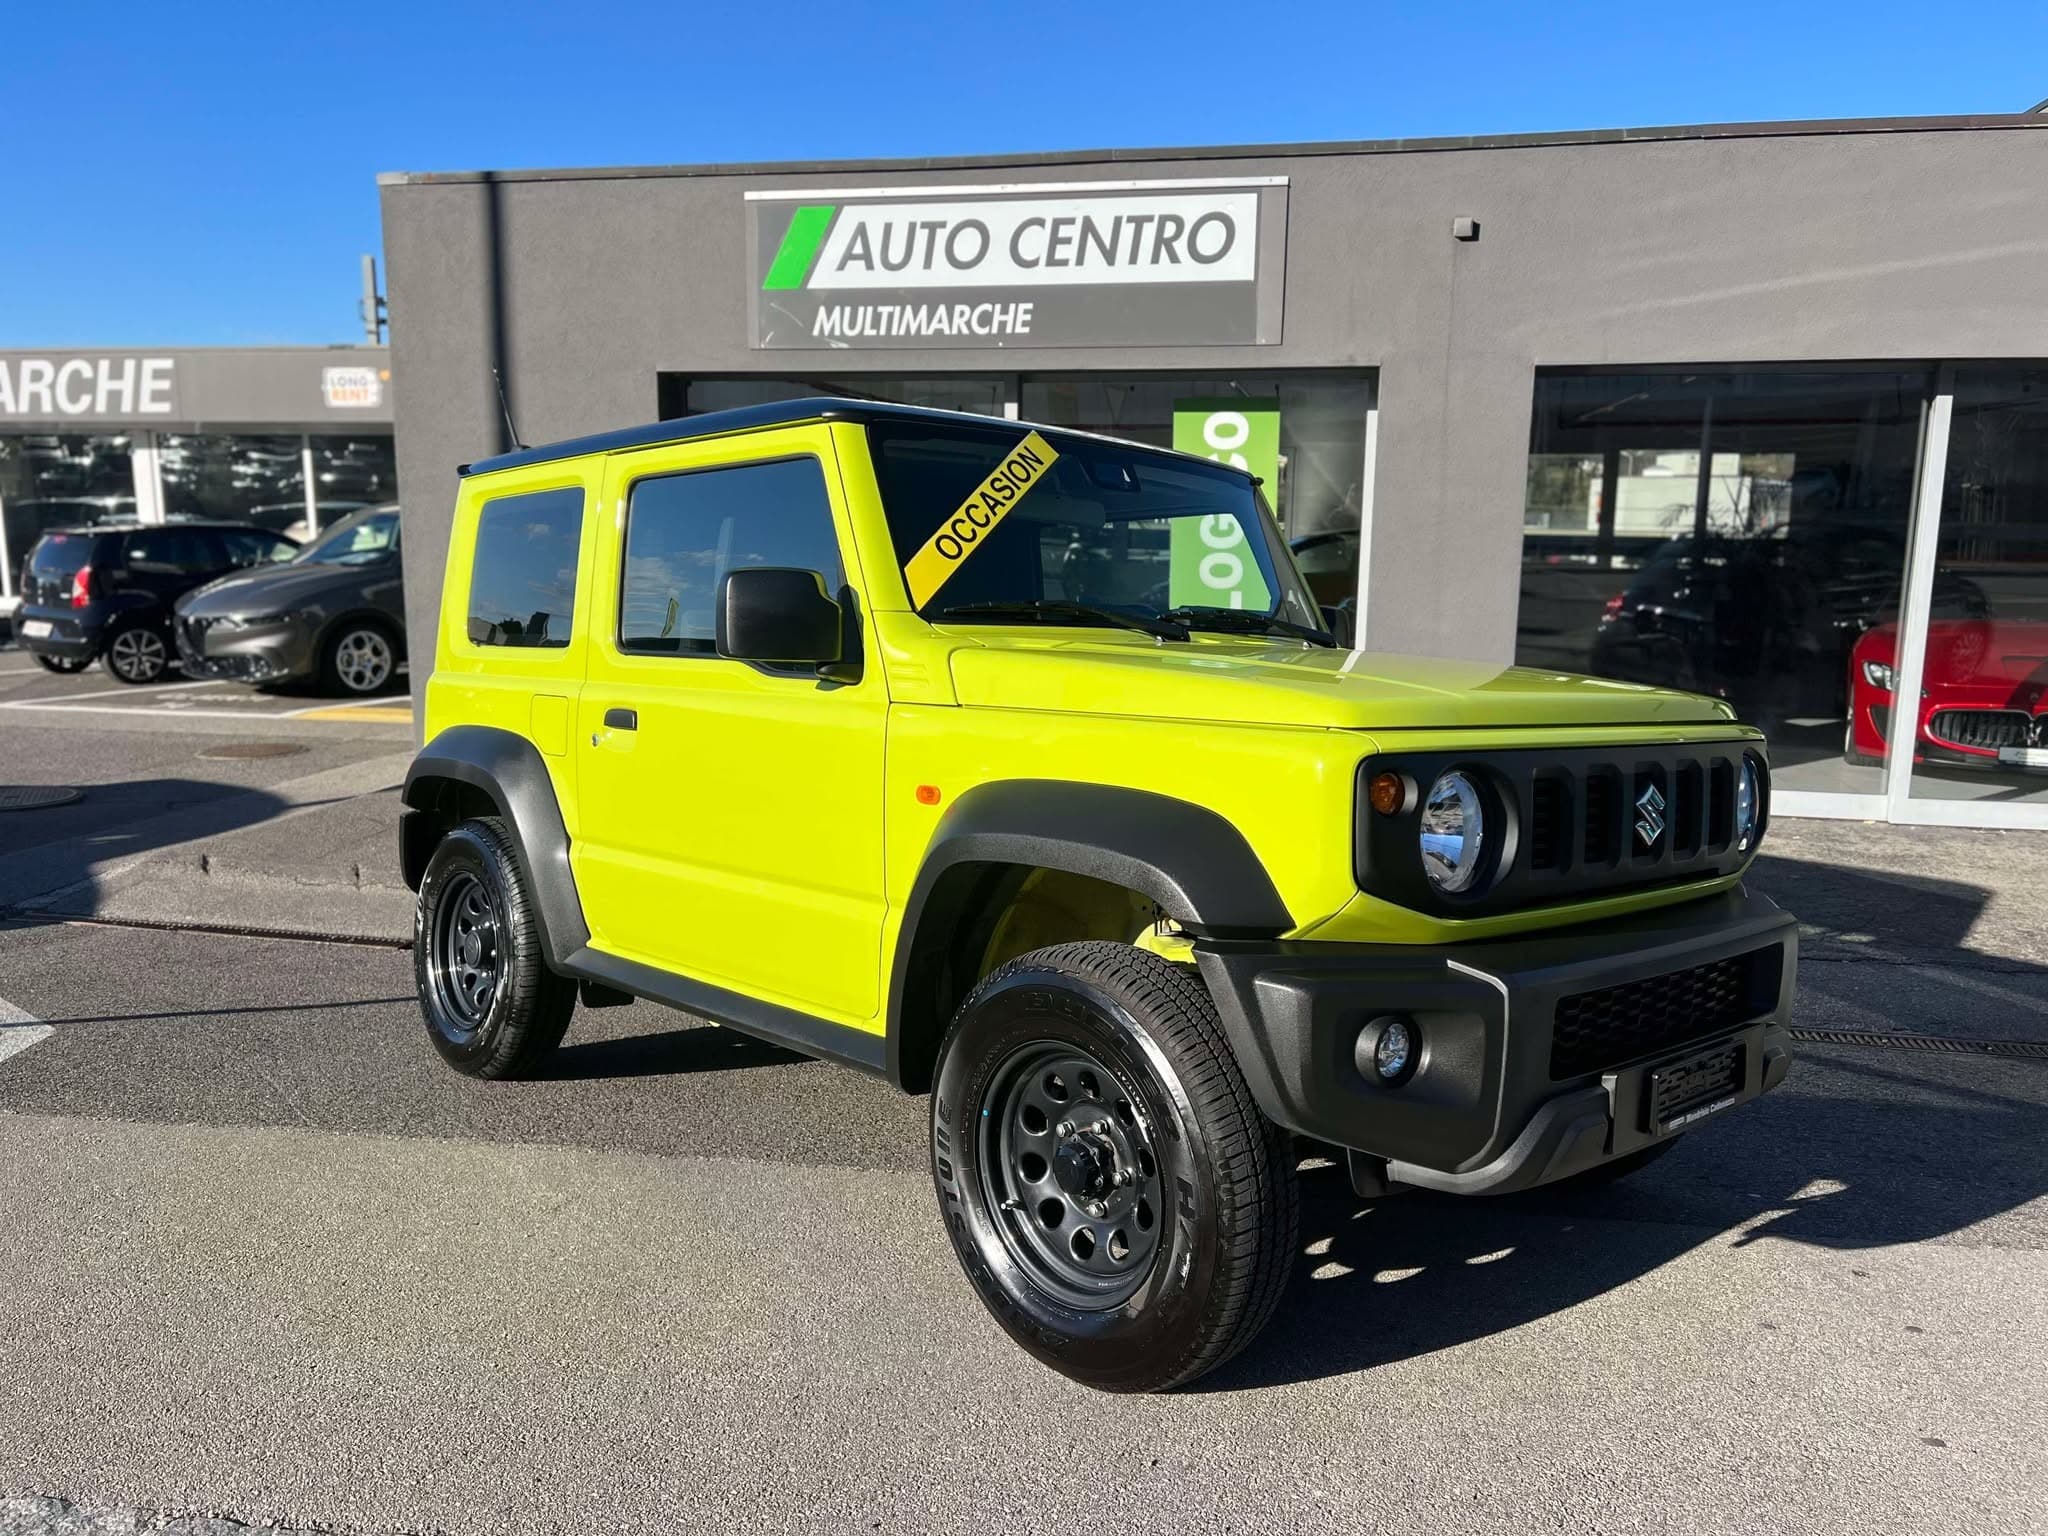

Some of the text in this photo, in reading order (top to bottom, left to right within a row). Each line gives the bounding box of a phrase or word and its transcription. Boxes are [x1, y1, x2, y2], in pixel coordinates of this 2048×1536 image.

[837, 211, 1236, 272] AUTO CENTRO
[813, 303, 1033, 337] MULTIMARCHE
[330, 375, 369, 387] LONG
[331, 388, 370, 401] RENT
[935, 446, 1044, 560] OCCASION
